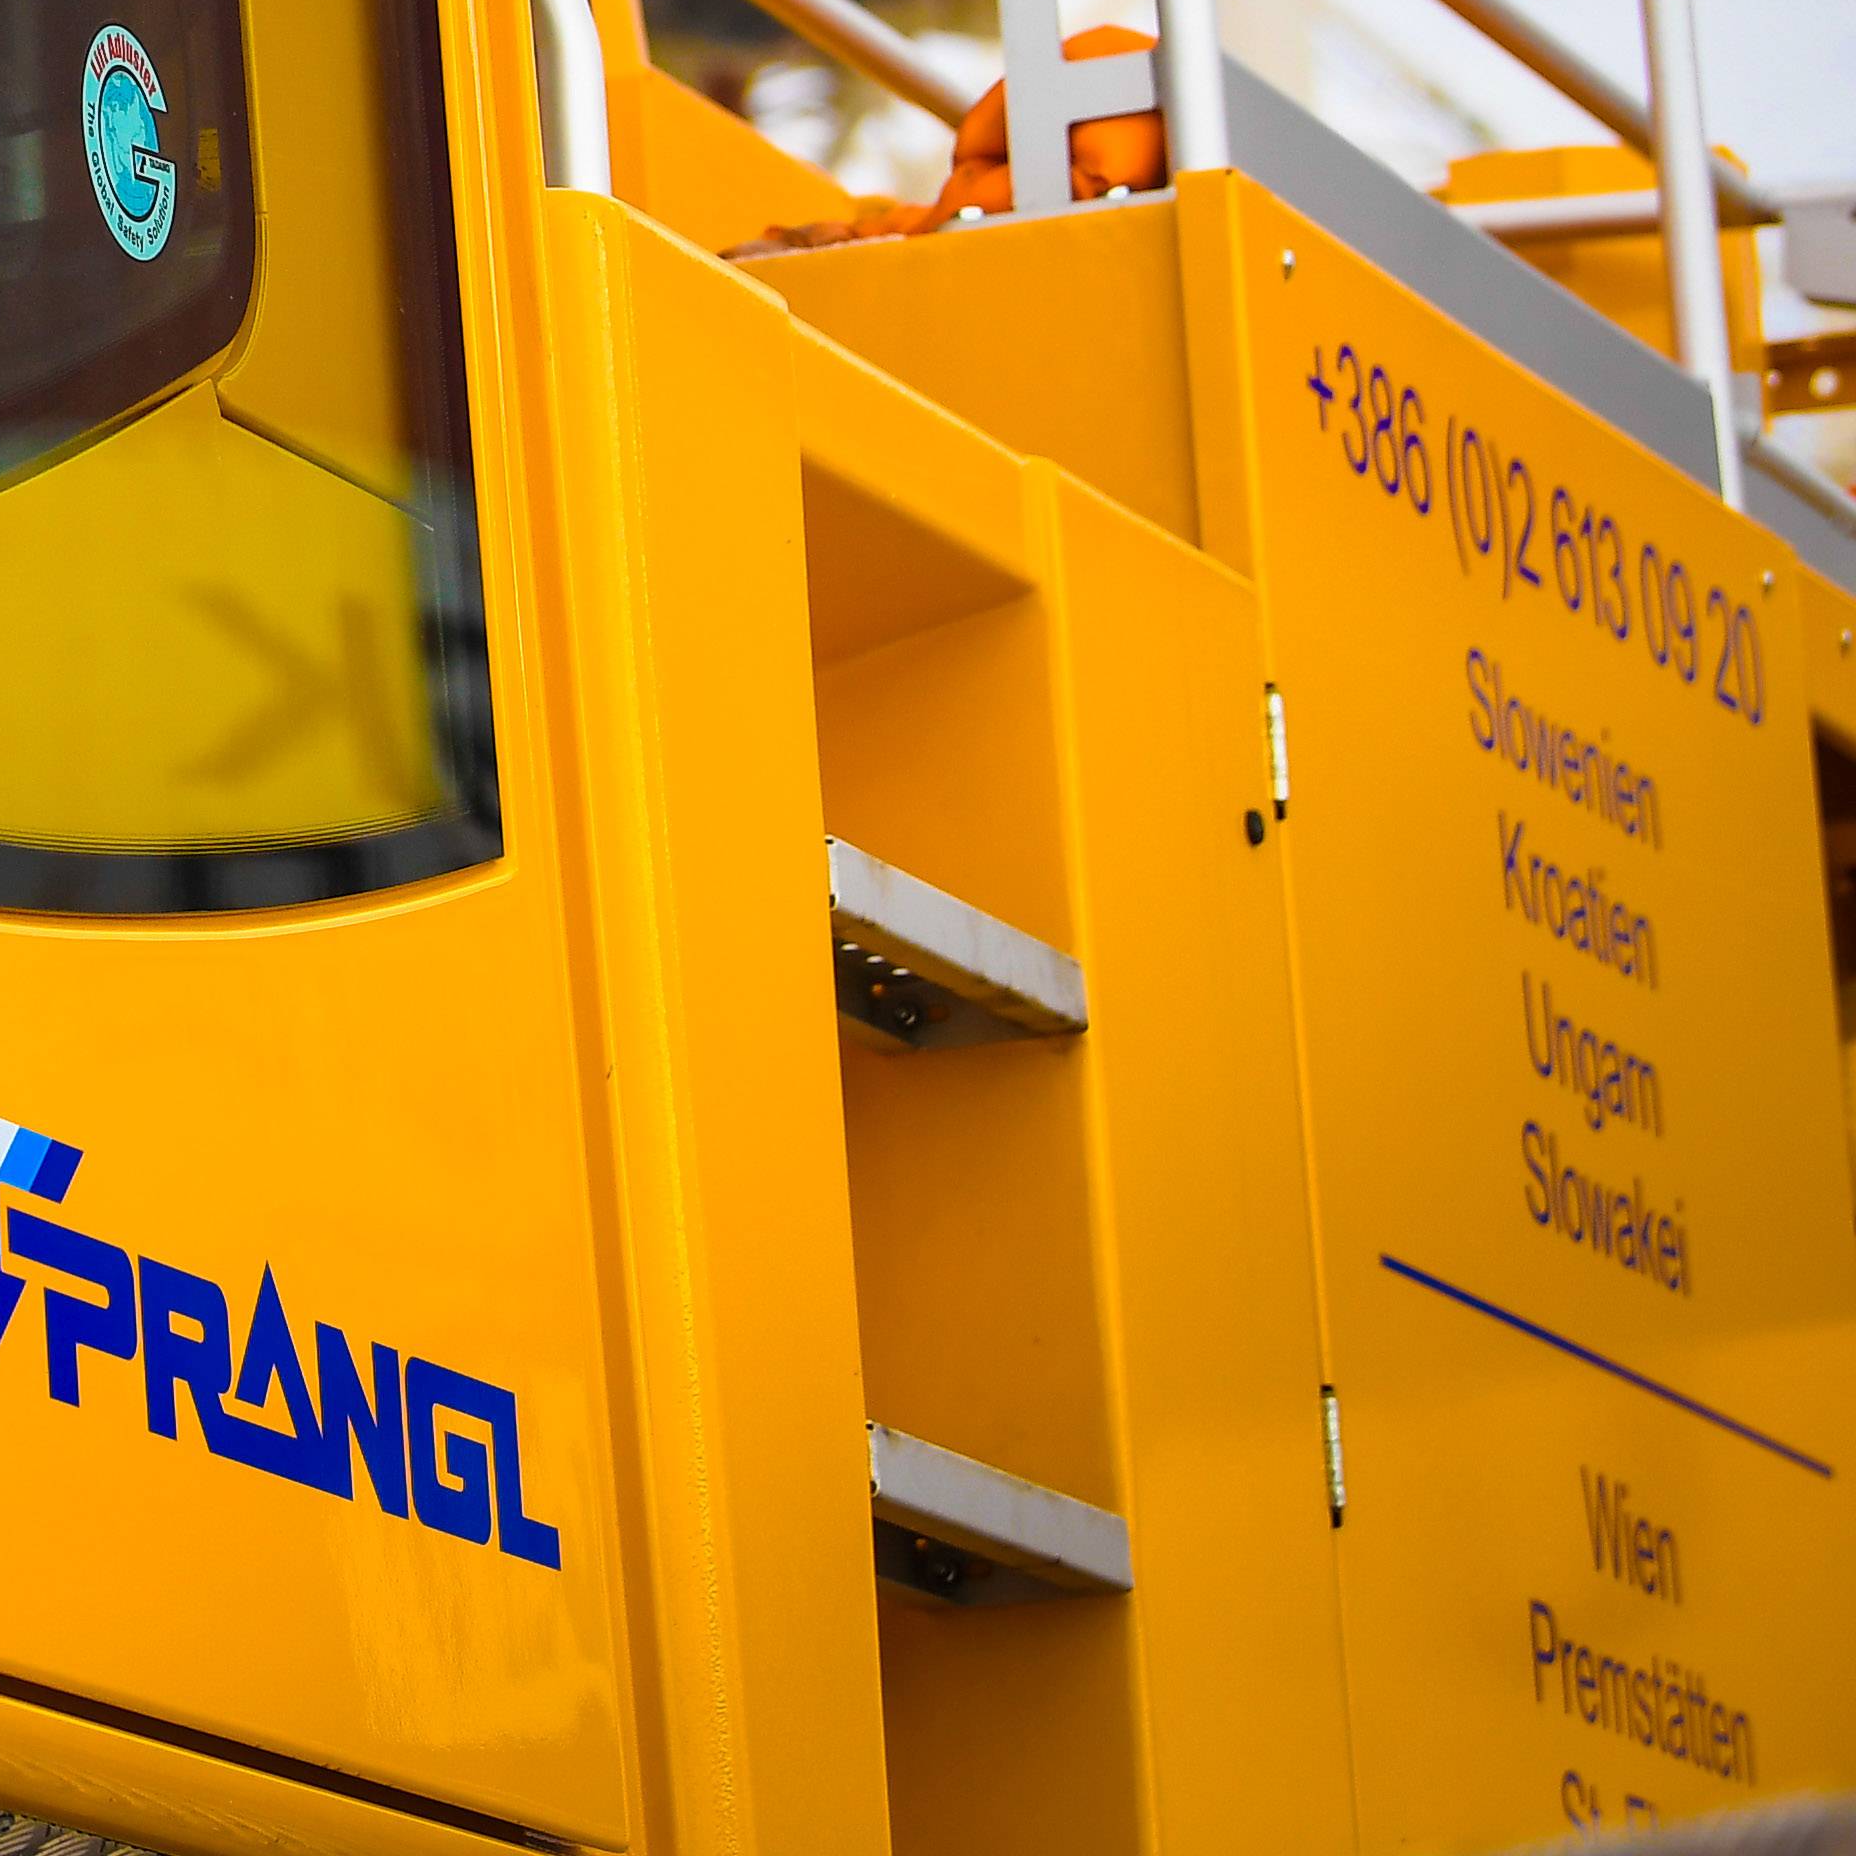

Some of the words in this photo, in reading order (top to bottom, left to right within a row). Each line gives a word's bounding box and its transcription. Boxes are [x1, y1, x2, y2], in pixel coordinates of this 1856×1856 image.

[87, 101, 96, 138] The
[91, 151, 115, 216] Global
[117, 214, 144, 253] Safety
[146, 184, 170, 246] Solution
[1306, 343, 1432, 516] +386
[1446, 414, 1541, 601] (0)2
[1551, 486, 1630, 641] 613
[1640, 542, 1698, 683] 09
[1707, 586, 1764, 727] 20
[1466, 646, 1664, 853] Slowenien
[1497, 808, 1660, 992] Kroatien
[1521, 968, 1664, 1139] Ungarn
[1521, 1119, 1692, 1298] Slowakei
[6, 1206, 562, 1572] PRANGL
[1580, 1463, 1682, 1606] Wien
[1529, 1597, 1759, 1788] Premstätten
